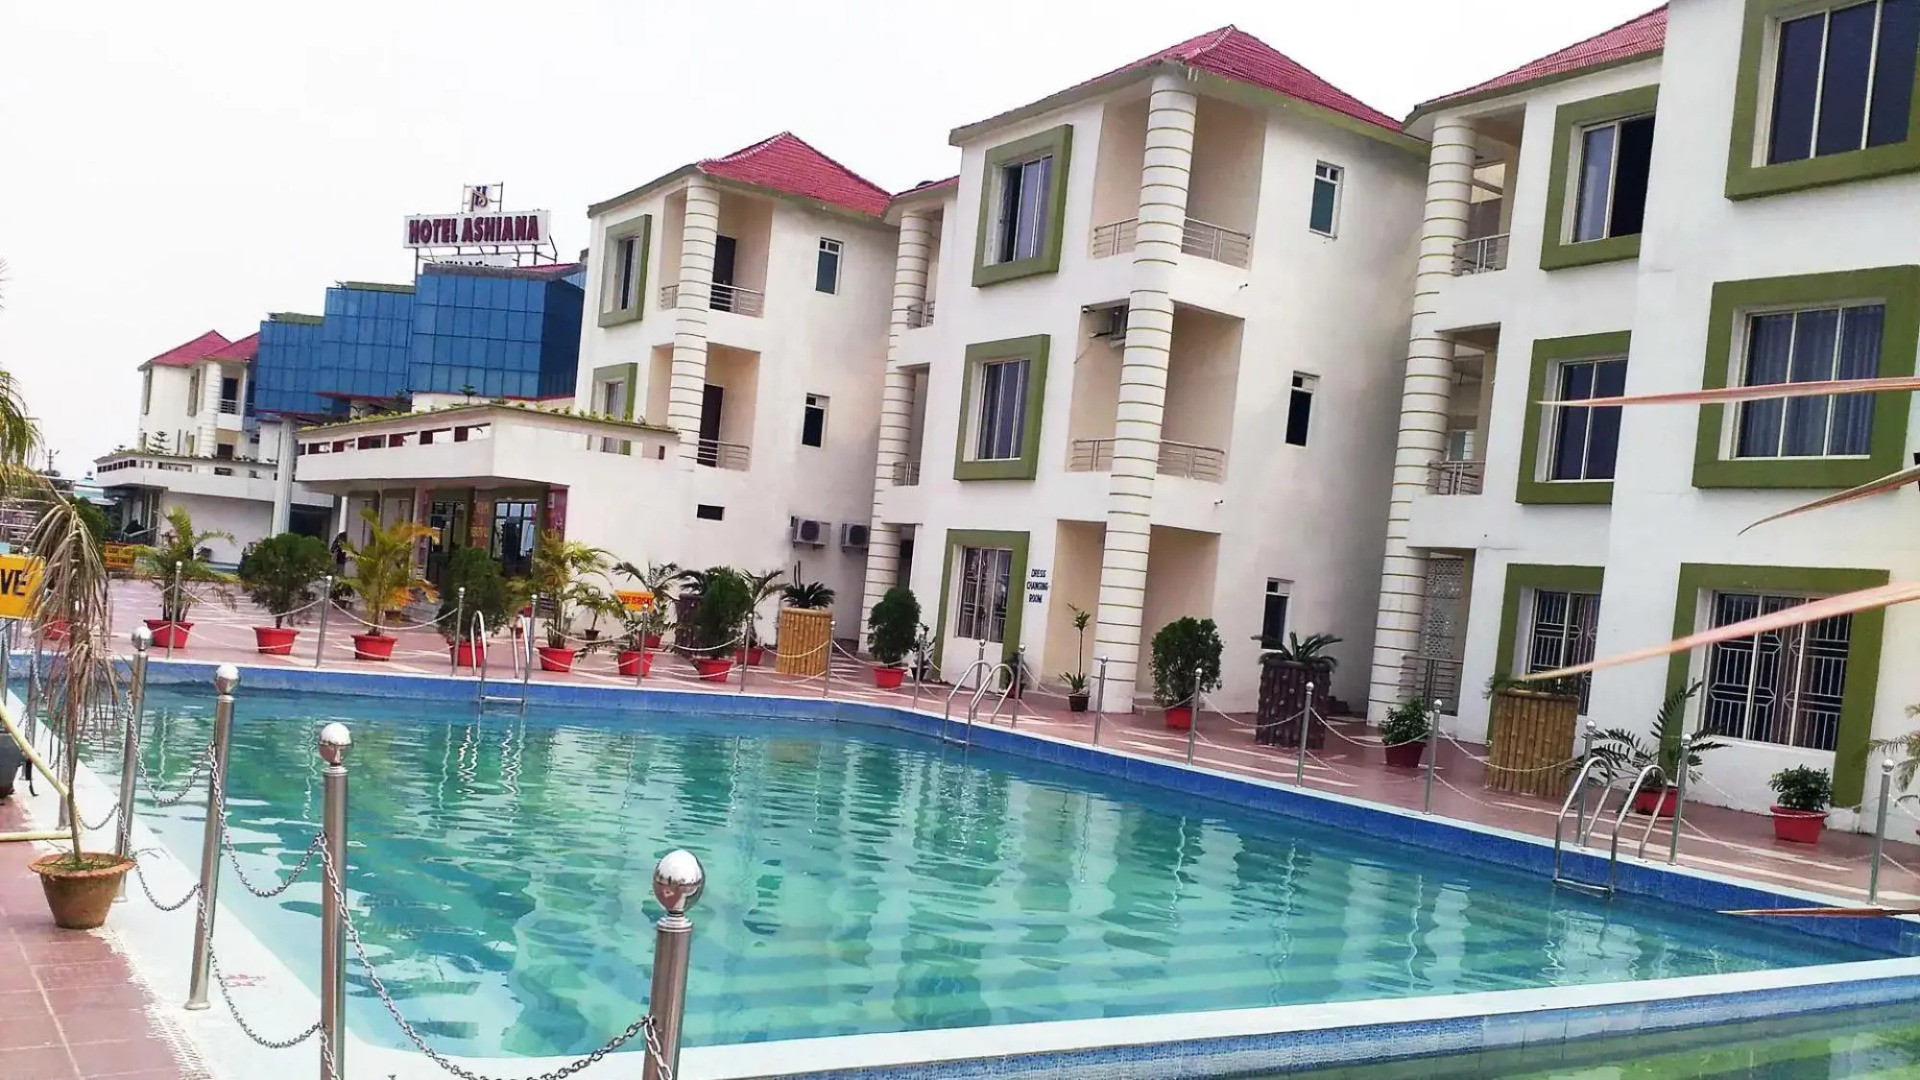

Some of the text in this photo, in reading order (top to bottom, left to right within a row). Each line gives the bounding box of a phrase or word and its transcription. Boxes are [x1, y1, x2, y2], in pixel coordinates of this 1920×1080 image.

[408, 215, 539, 244] HOTEL ASHIANA
[1031, 568, 1047, 578] DRESS
[1028, 593, 1043, 603] ROOM
